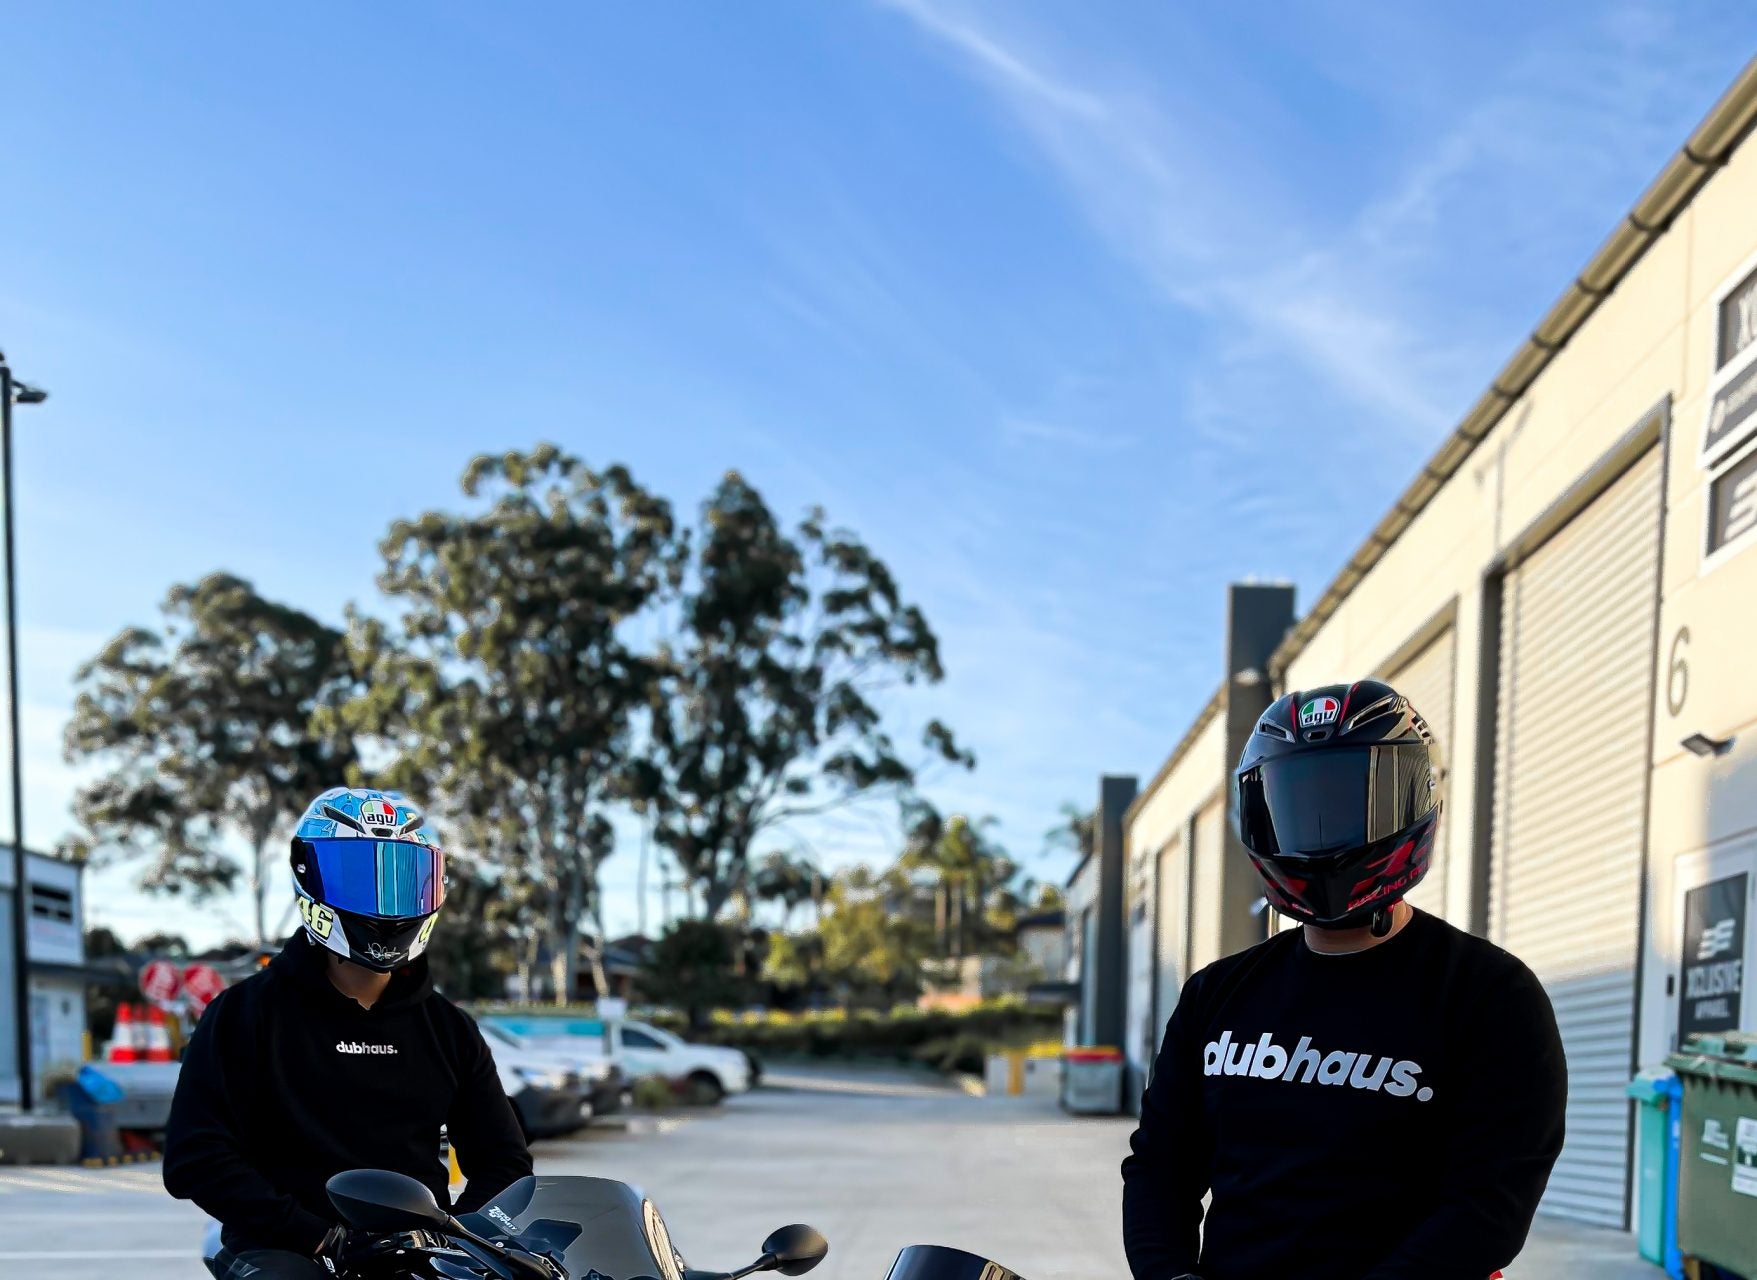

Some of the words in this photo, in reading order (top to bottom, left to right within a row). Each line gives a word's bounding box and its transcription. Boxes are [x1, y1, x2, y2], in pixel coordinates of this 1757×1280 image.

[1667, 625, 1689, 717] 6
[367, 813, 394, 826] agv
[336, 1040, 398, 1055] dubhaus.
[1203, 1030, 1434, 1102] dubhaus.
